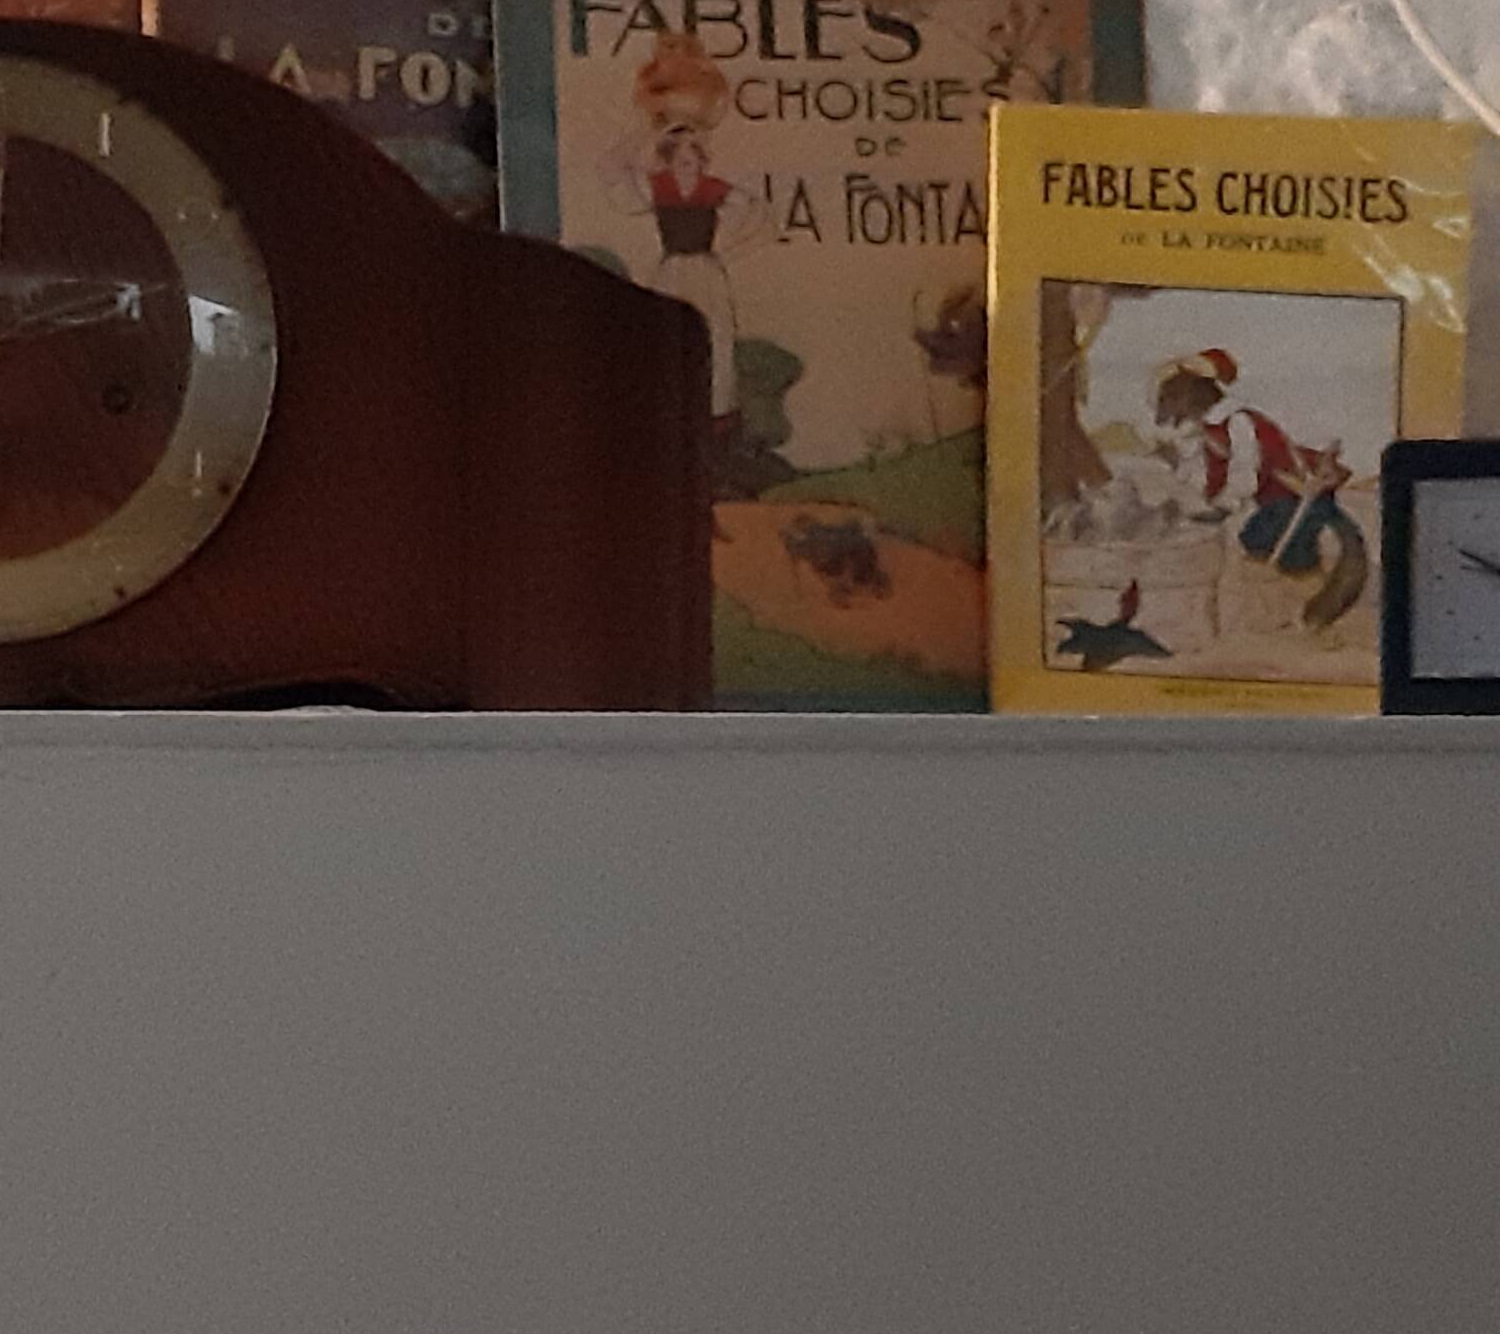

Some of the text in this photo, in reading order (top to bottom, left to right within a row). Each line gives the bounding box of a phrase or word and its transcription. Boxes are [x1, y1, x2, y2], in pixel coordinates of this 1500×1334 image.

[844, 173, 988, 245] FONTA
[1041, 161, 1410, 224] FABLES CHOISIES
[1161, 230, 1193, 250] LA
[1205, 231, 1327, 257] FONTAINE
